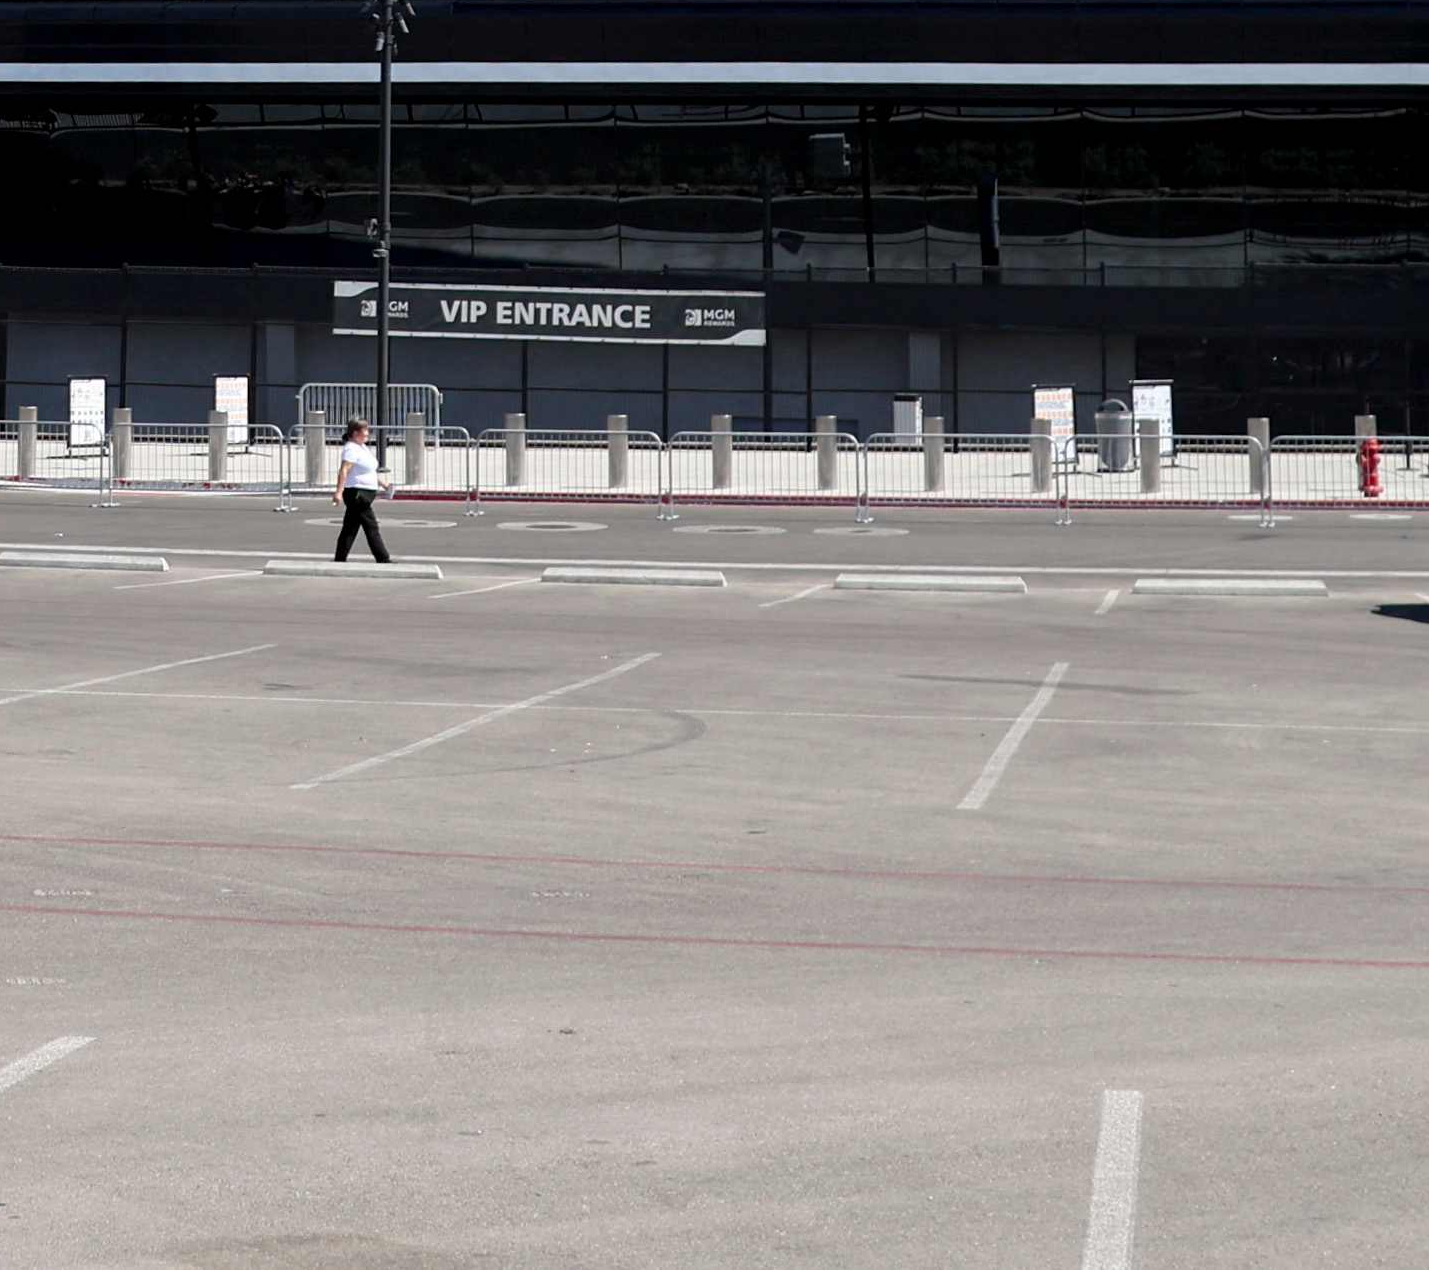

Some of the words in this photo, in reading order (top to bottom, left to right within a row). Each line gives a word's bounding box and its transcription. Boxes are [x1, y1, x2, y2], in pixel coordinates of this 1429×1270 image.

[440, 300, 488, 323] VIP
[496, 301, 652, 329] ENTRANCE
[703, 308, 735, 321] MGM
